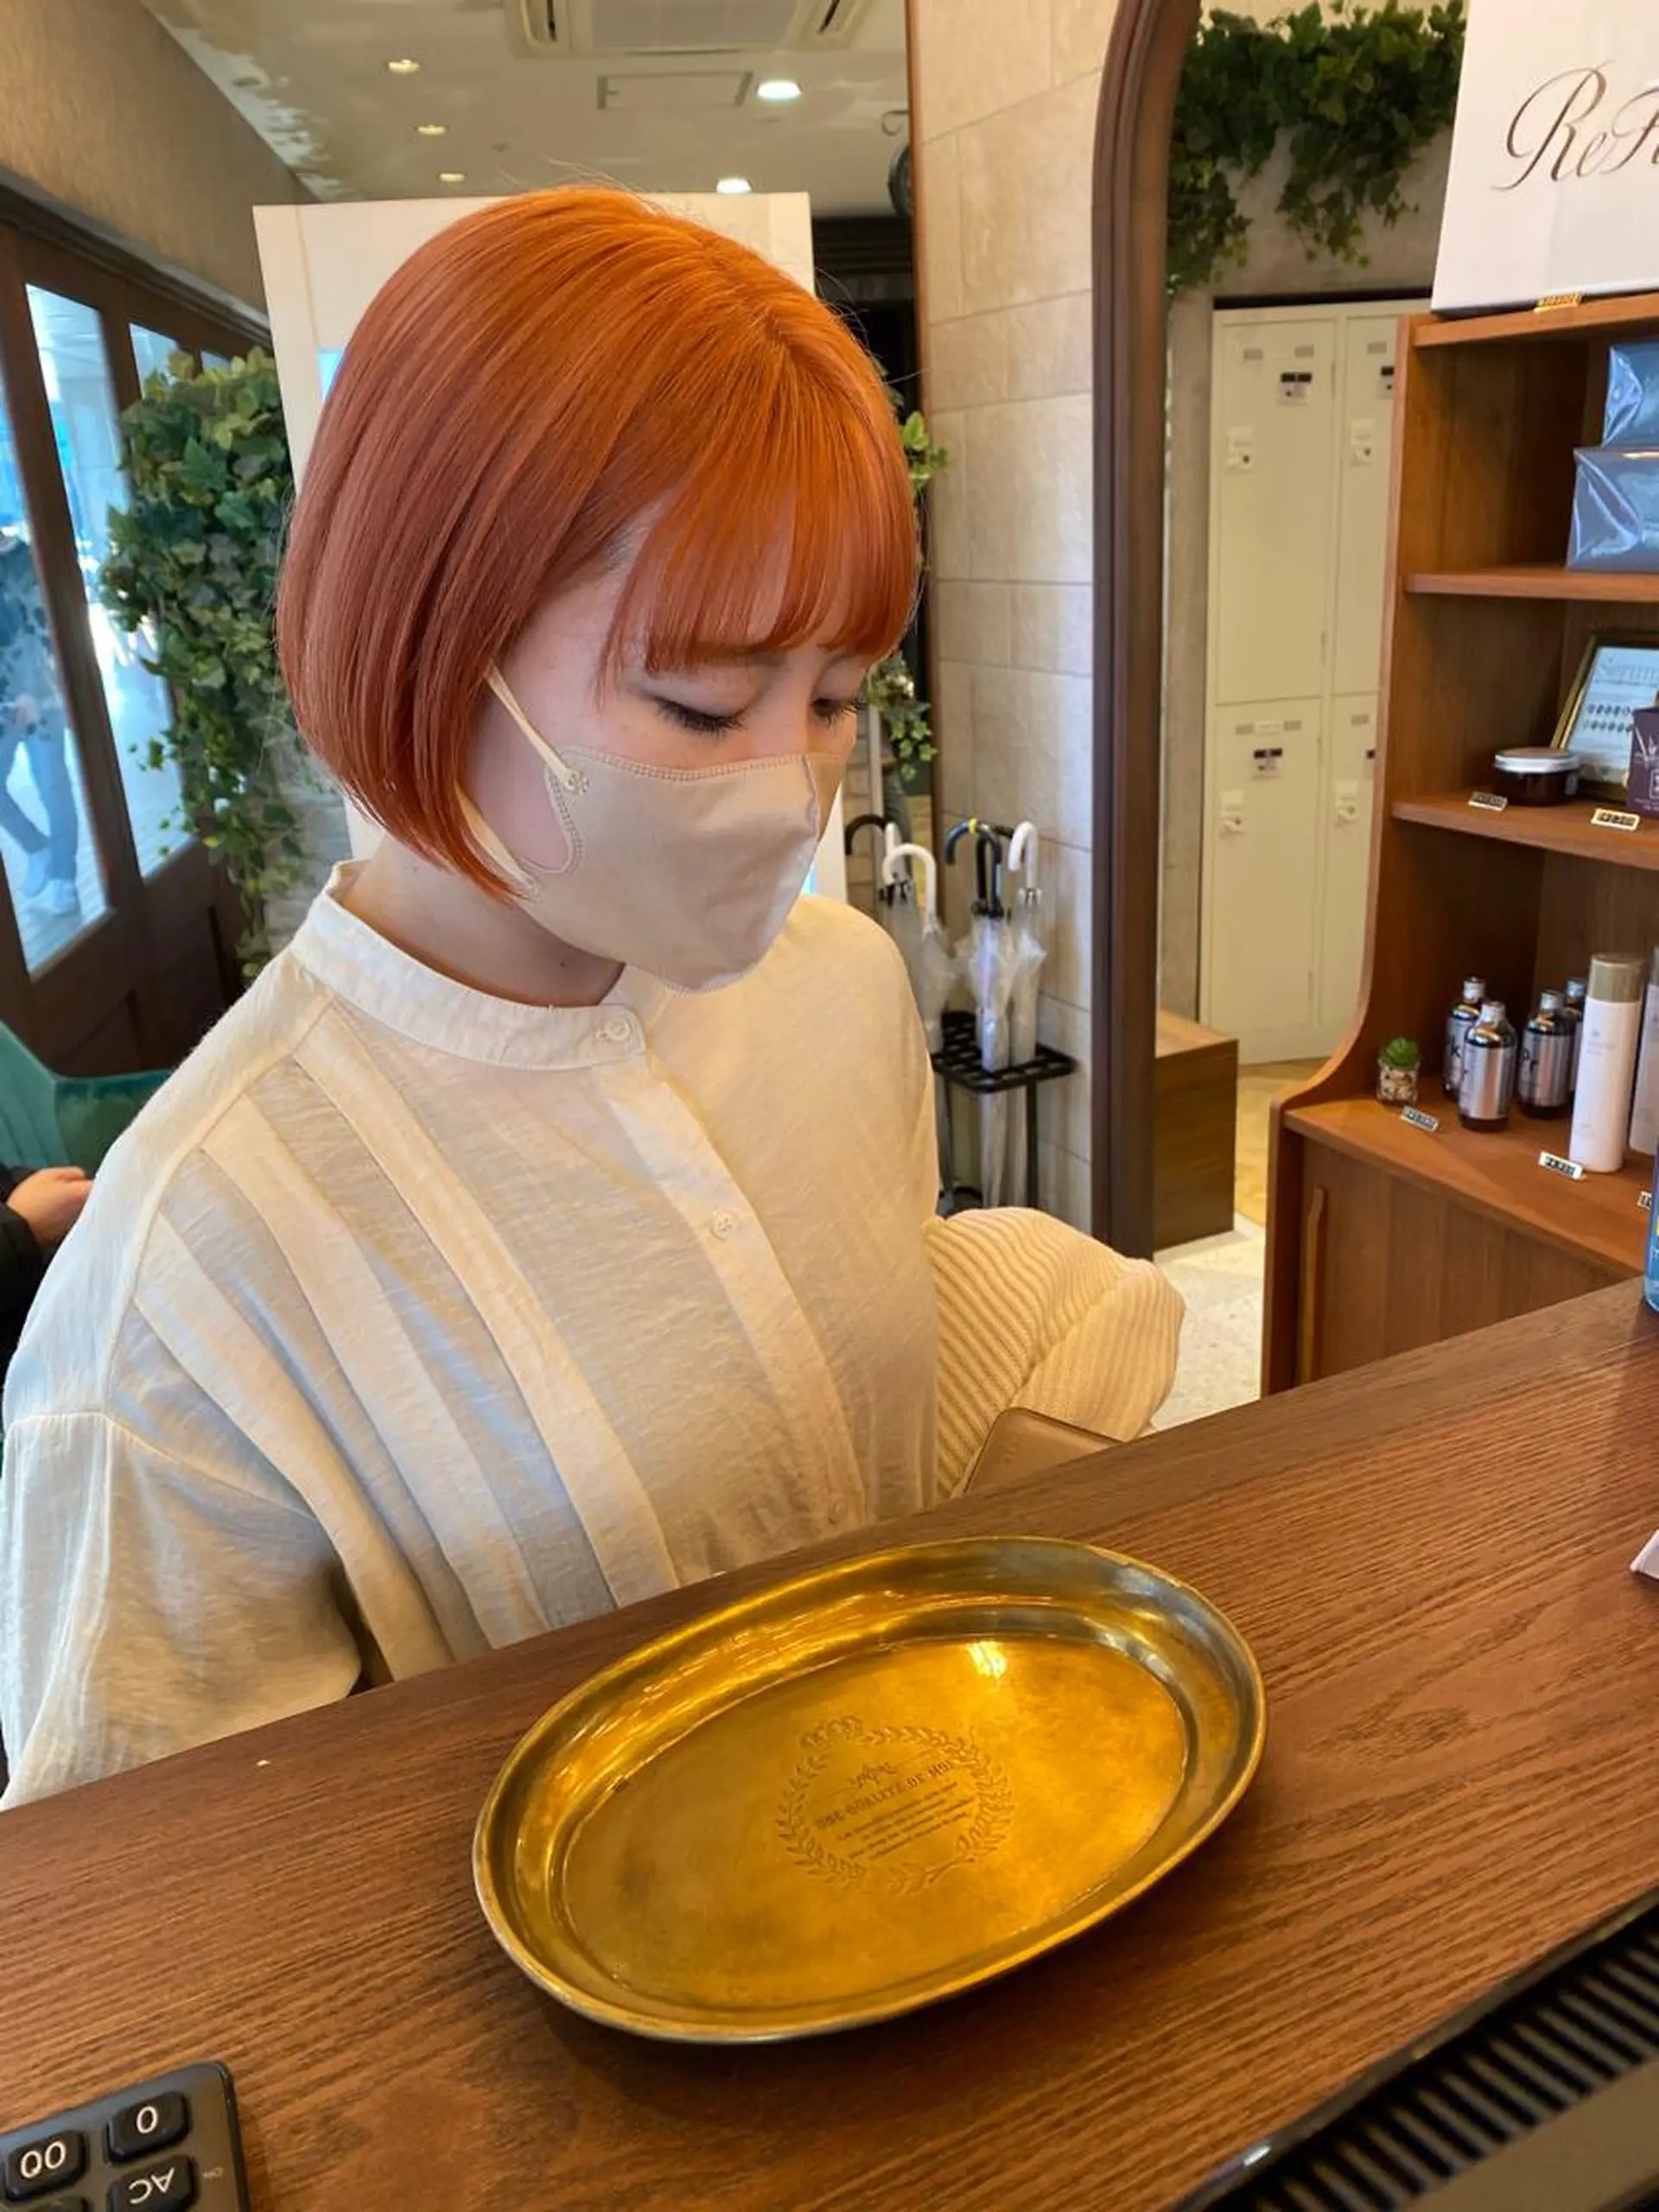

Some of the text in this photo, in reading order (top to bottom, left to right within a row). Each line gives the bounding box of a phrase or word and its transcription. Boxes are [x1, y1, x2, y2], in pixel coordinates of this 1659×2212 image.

[136, 2106, 158, 2133] 0
[21, 2140, 67, 2179] 00
[129, 2167, 175, 2204] AC
